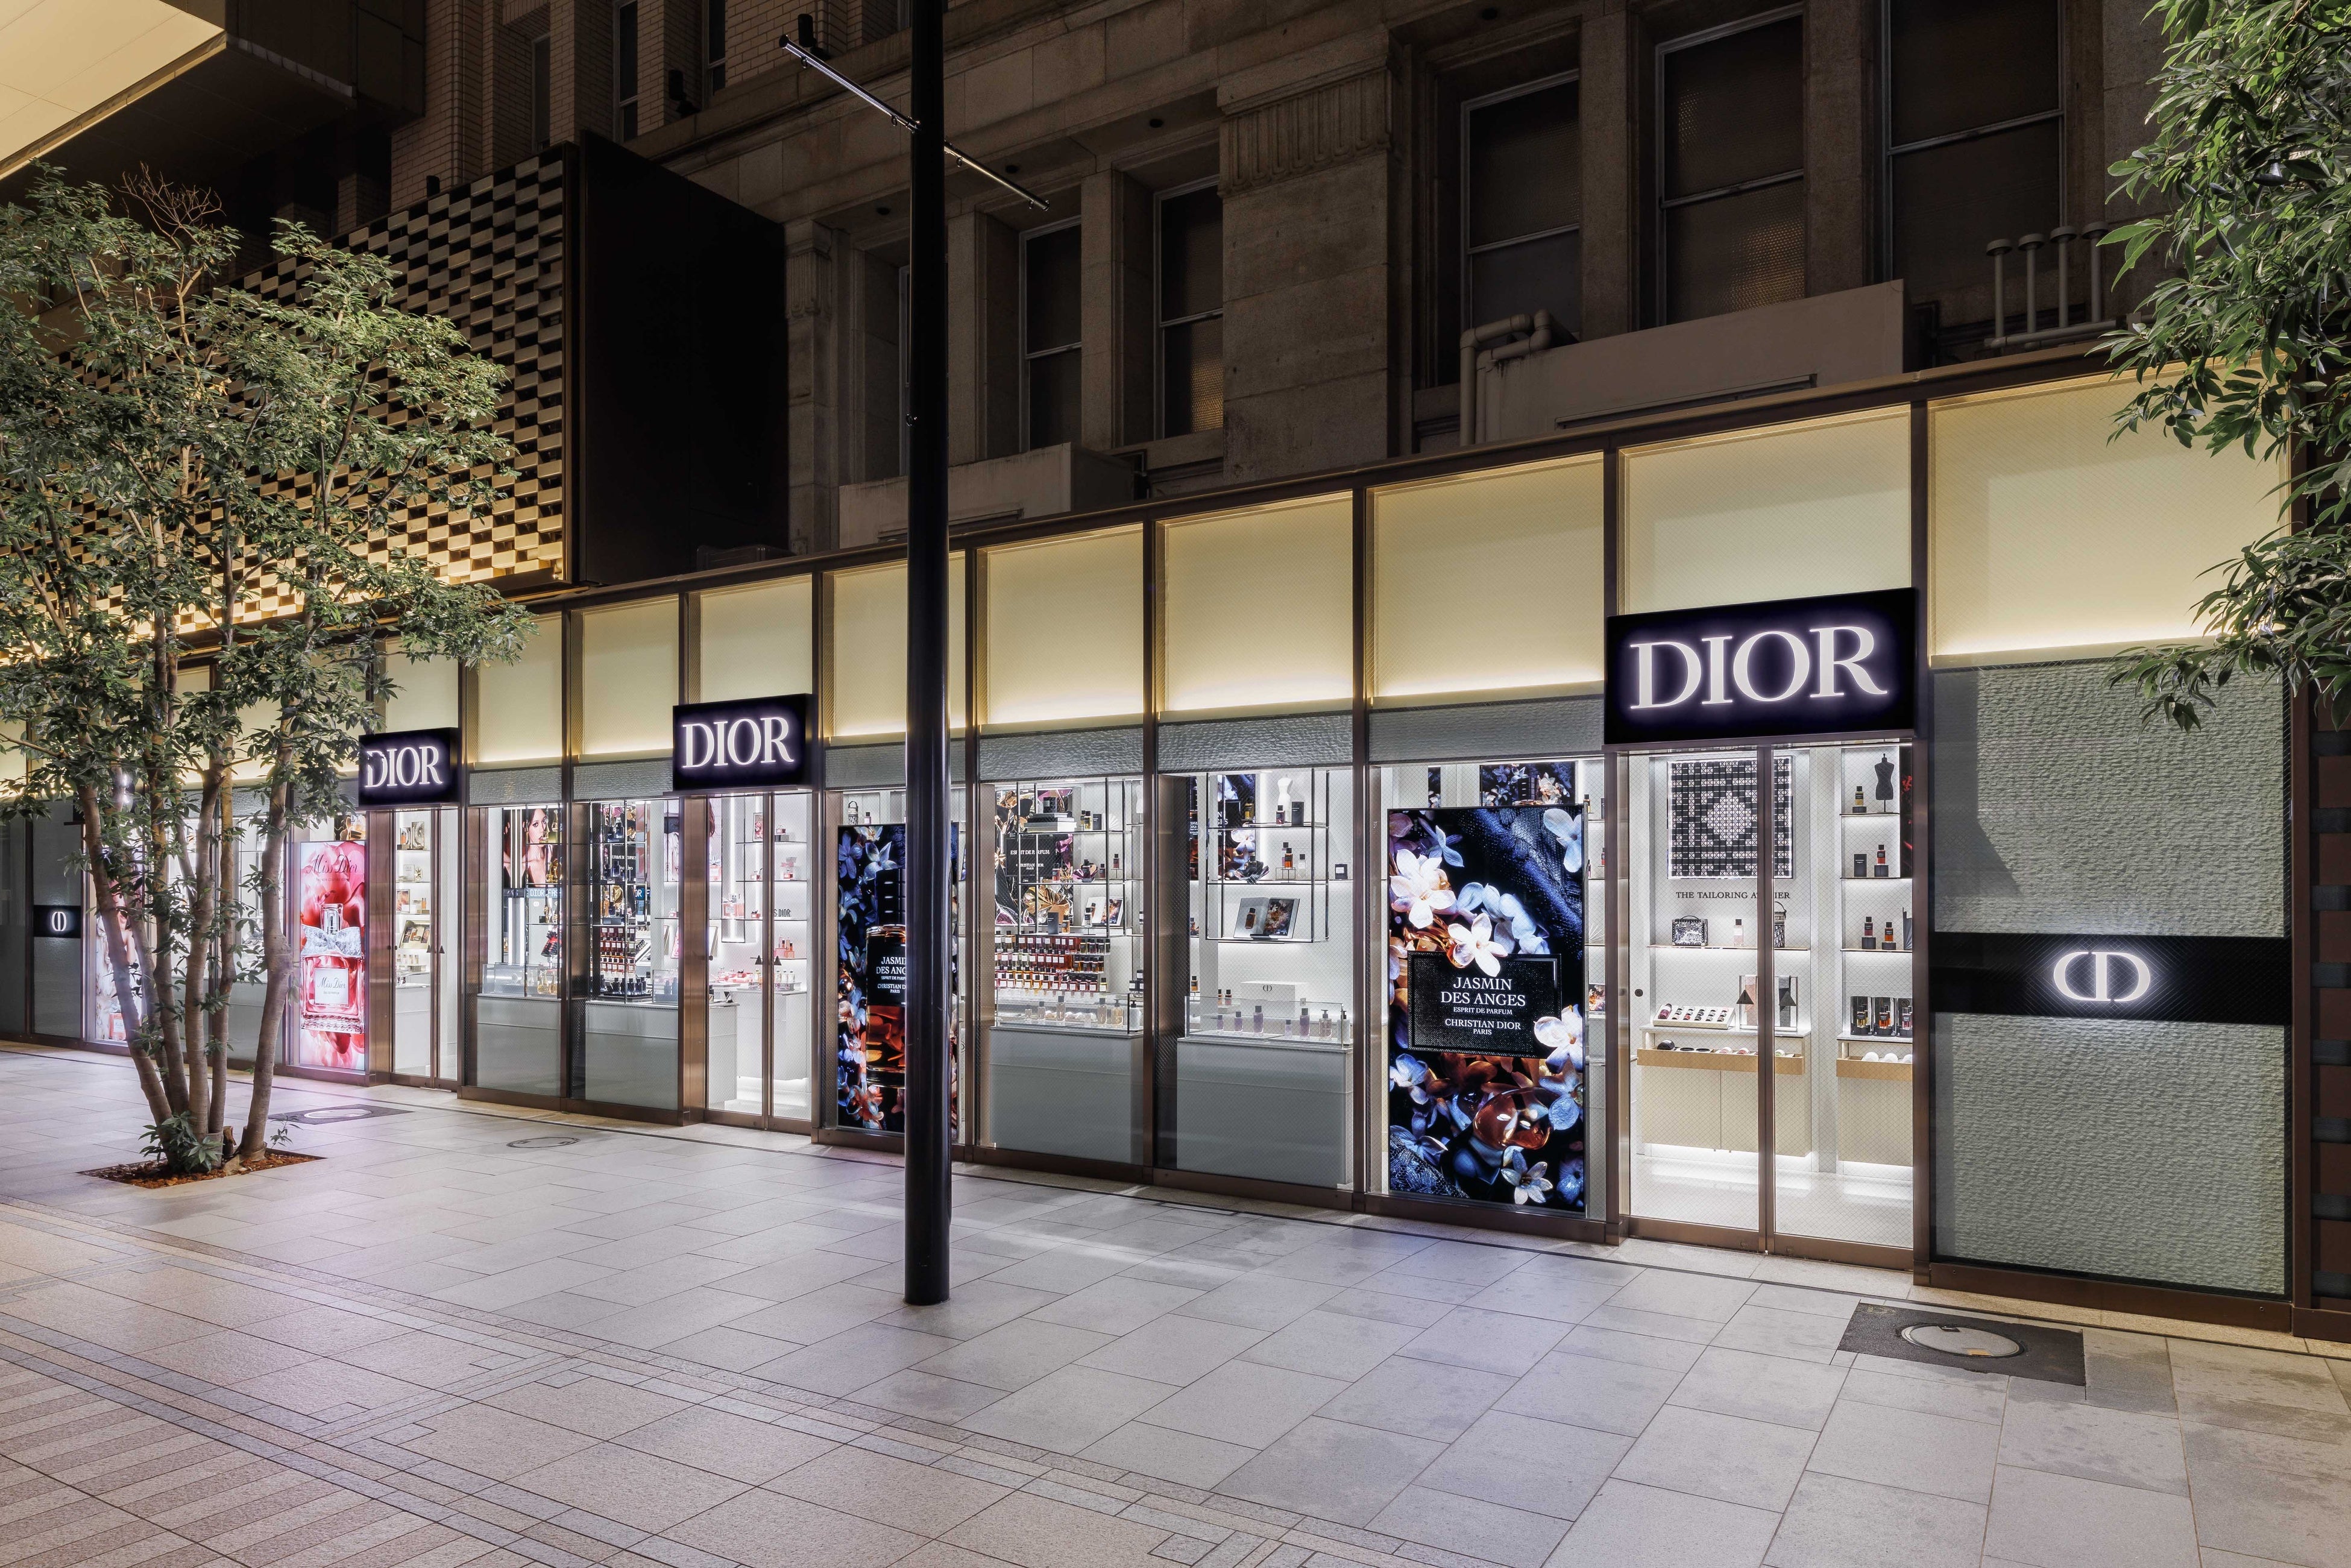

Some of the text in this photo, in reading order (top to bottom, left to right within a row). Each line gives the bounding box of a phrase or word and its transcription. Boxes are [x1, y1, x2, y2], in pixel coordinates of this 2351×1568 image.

[1630, 626, 1888, 710] DIOR
[682, 717, 795, 769] DIOR
[364, 746, 443, 788] DIOR
[306, 854, 357, 874] Miss Dior
[530, 889, 545, 897] DIOR
[778, 908, 791, 917] DIOR
[317, 977, 347, 989] Miss Dior
[1453, 977, 1512, 990] JASMIN
[1440, 991, 1526, 1007] DES ANGES
[1444, 1018, 1522, 1030] CHRISTIAN DIOR
